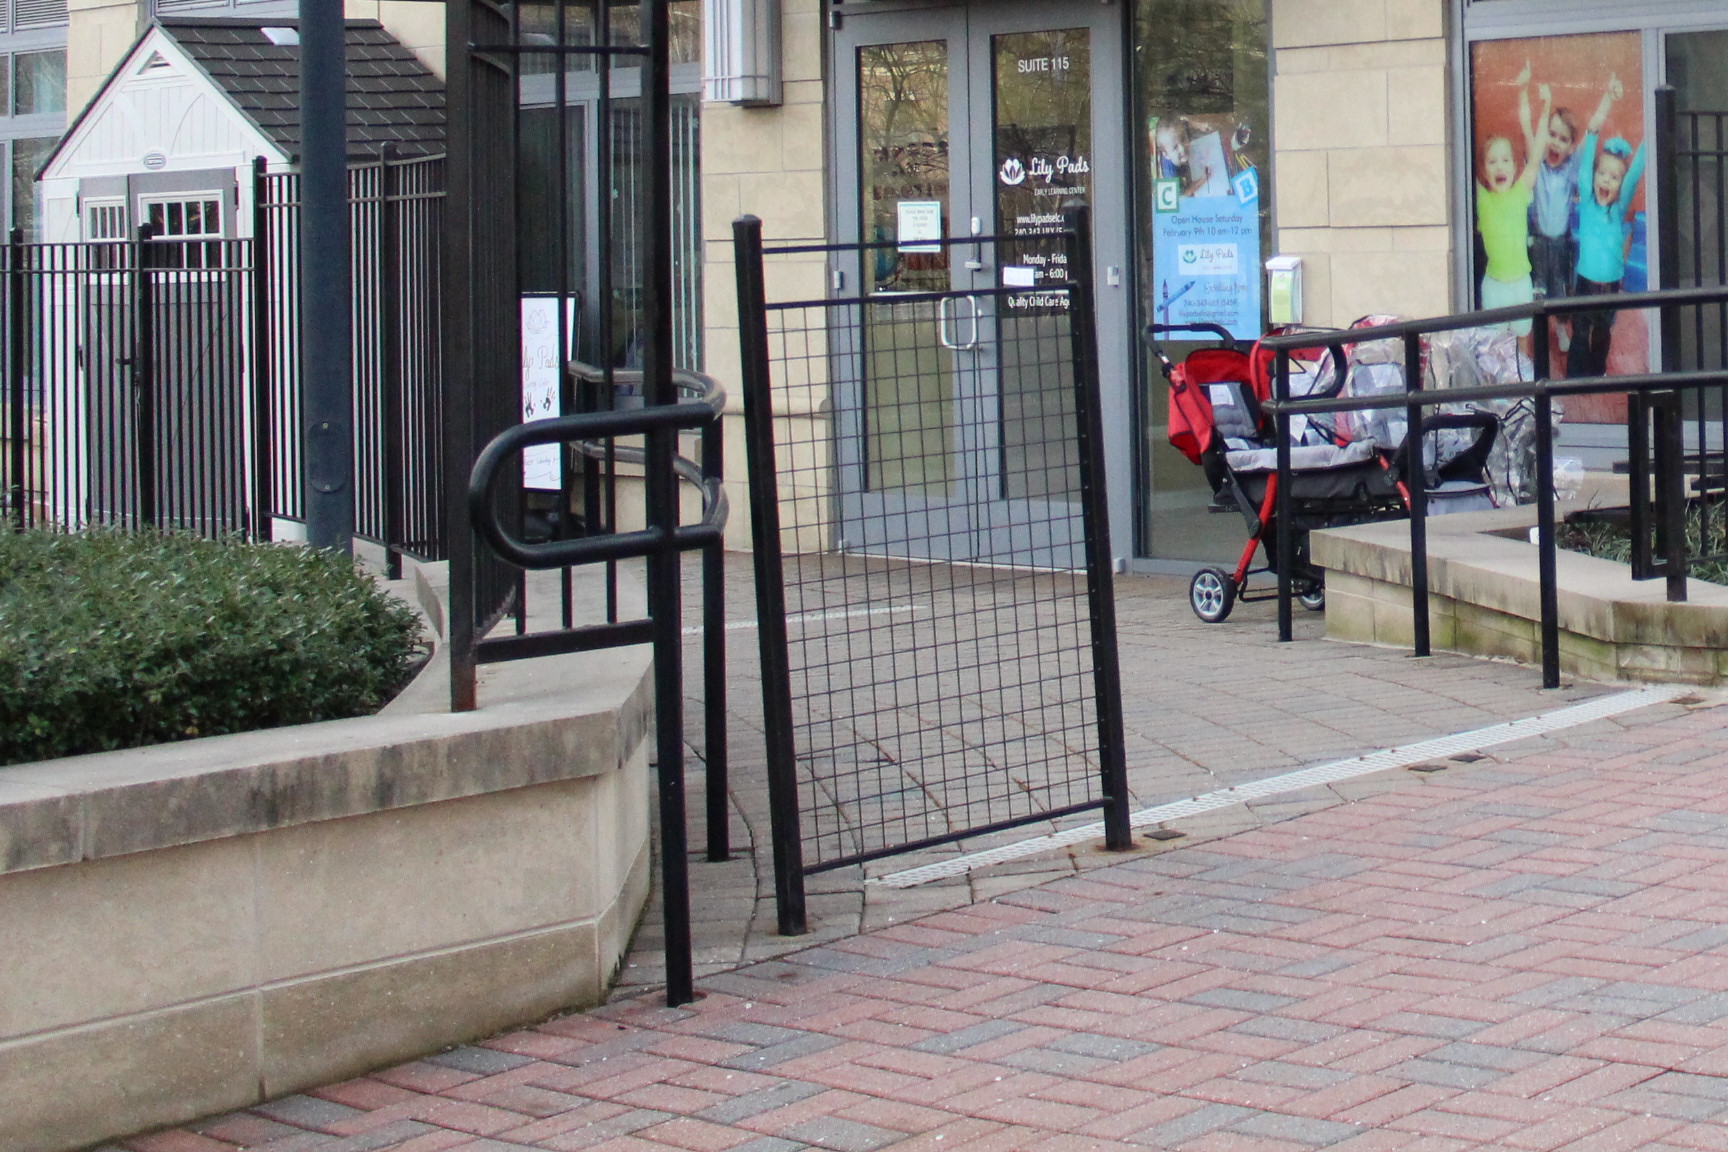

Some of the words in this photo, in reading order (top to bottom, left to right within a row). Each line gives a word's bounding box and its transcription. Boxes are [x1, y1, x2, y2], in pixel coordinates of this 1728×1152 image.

[1018, 57, 1049, 73] SUITE
[1051, 56, 1070, 70] 115
[1029, 157, 1055, 184] Lily
[1056, 155, 1090, 175] Pads
[1161, 185, 1173, 206] C
[1240, 178, 1254, 198] B
[1171, 215, 1191, 226] Open
[1192, 215, 1214, 224] House
[1215, 213, 1244, 224] Saturday
[1163, 228, 1192, 238] February
[1207, 227, 1216, 236] 10
[1240, 227, 1253, 236] pm
[1023, 254, 1047, 267] Monday
[1052, 253, 1067, 264] Frida
[1200, 248, 1215, 263] Lily
[1215, 248, 1234, 259] Pads
[1049, 268, 1064, 279] 6:00
